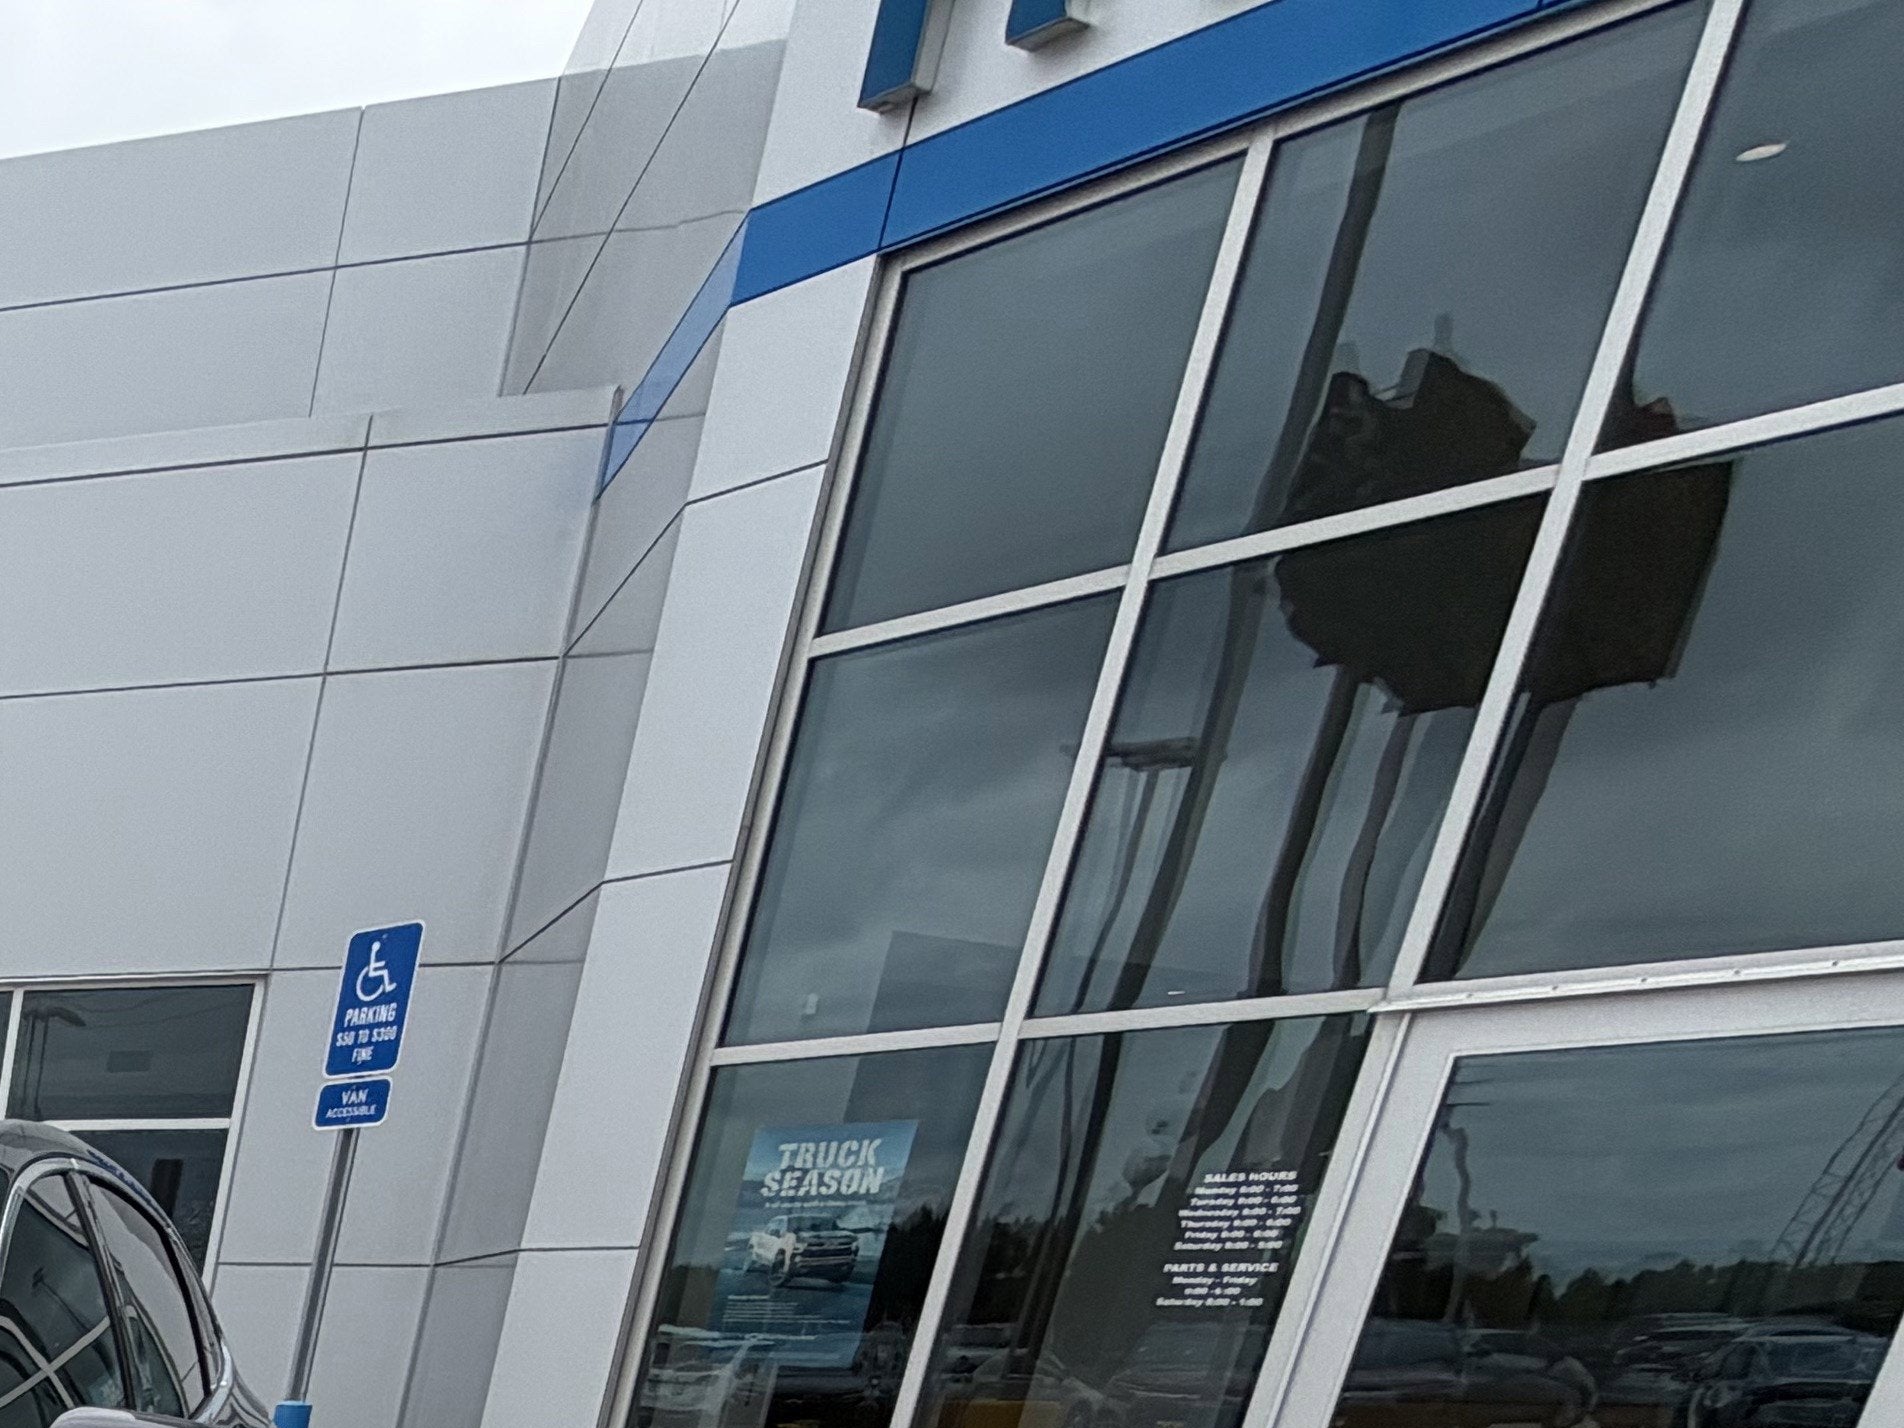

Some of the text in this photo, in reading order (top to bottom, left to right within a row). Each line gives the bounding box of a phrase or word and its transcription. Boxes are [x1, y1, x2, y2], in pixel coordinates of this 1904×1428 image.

[344, 1002, 397, 1027] PARKING
[357, 1029, 370, 1044] TO
[351, 1046, 374, 1063] FINE
[342, 1089, 369, 1105] VAN
[325, 1104, 376, 1119] ACCESSIBLE
[778, 1138, 882, 1169] TRUCK
[760, 1166, 885, 1196] SEASON
[1203, 1171, 1298, 1183] SALES HOURS
[1162, 1262, 1279, 1273] PARTS & SERVICE
